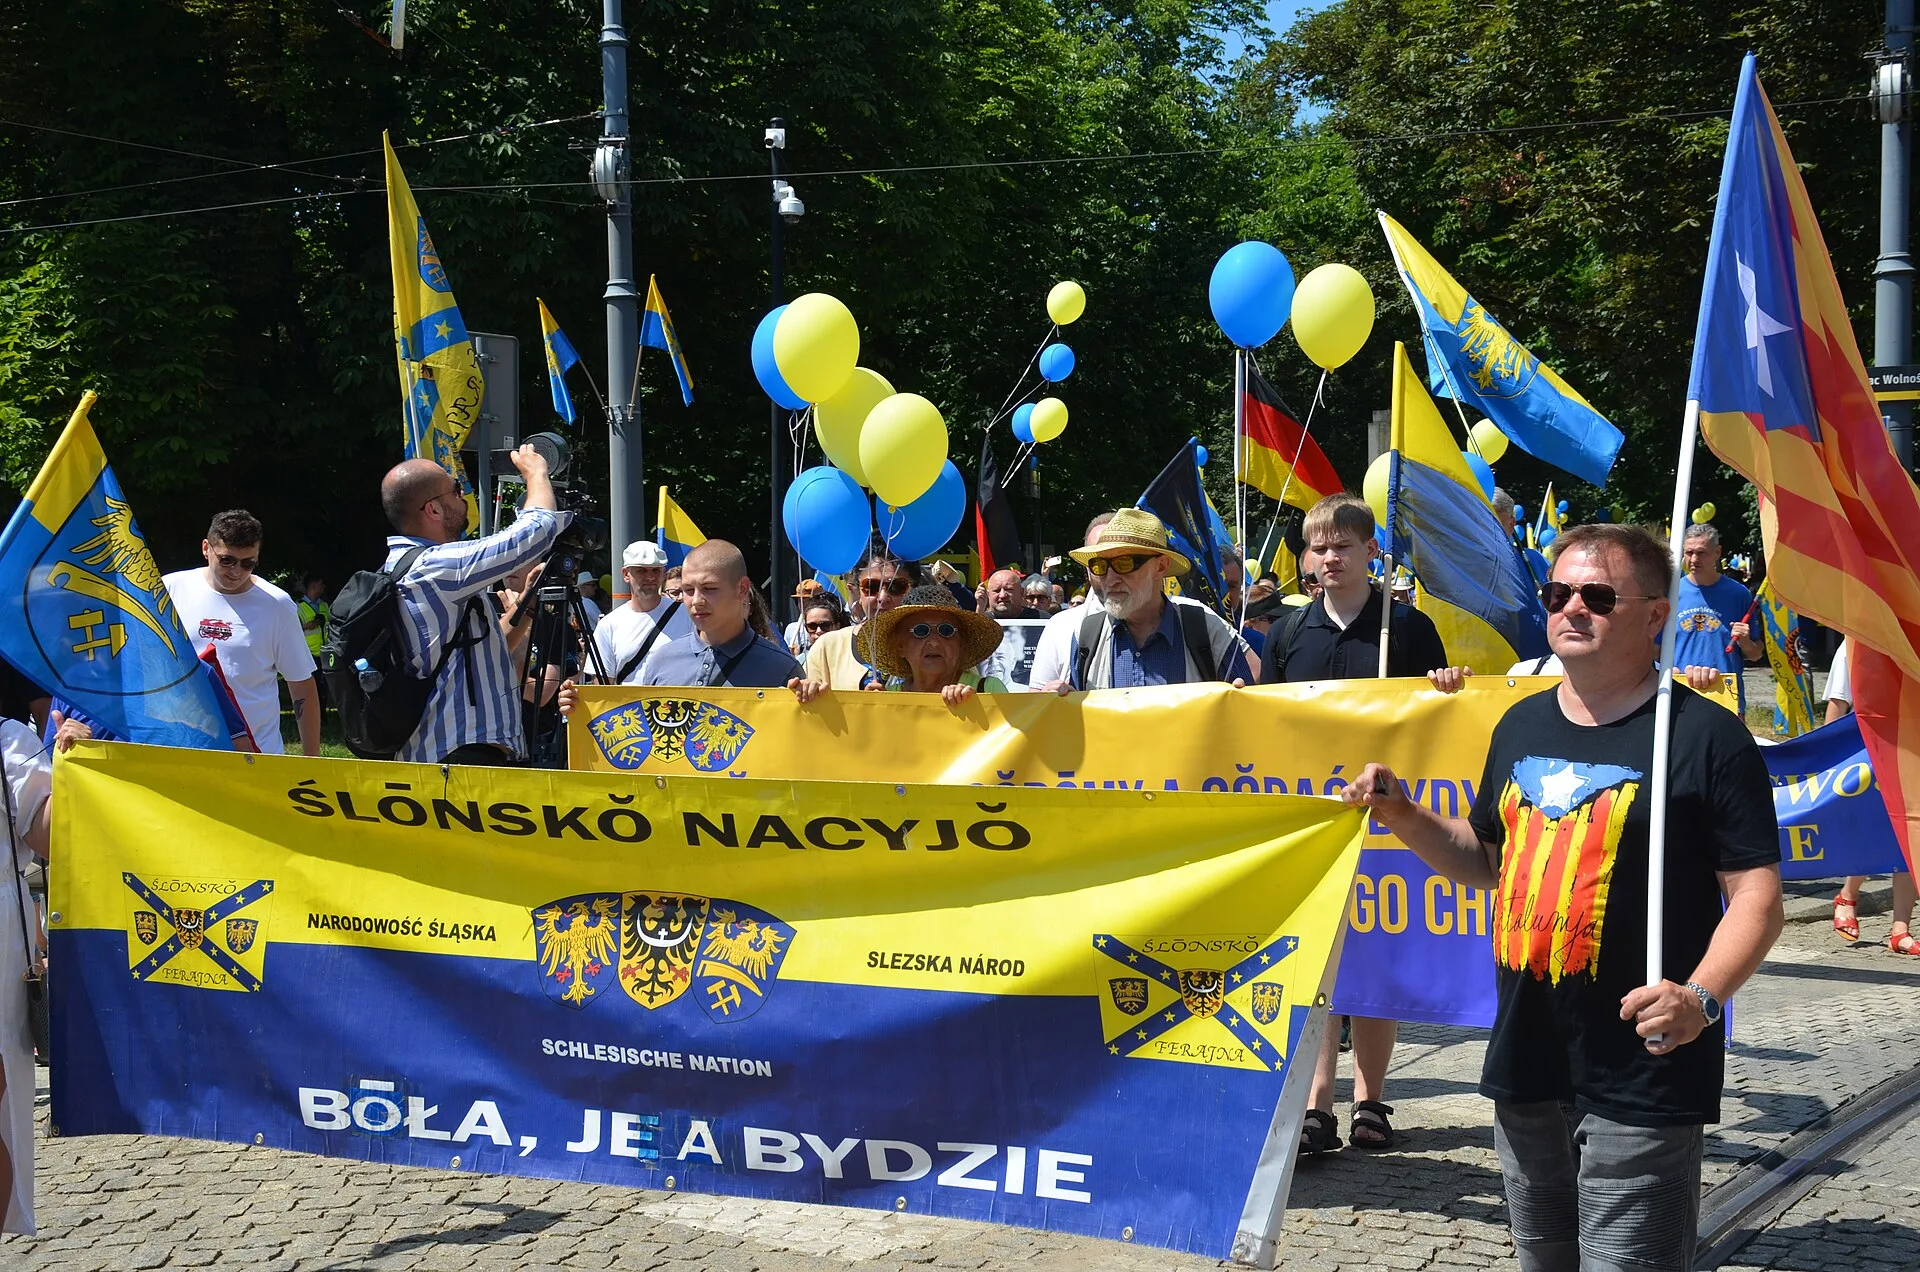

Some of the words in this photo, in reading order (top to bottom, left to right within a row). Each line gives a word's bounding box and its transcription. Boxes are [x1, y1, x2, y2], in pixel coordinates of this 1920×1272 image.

[287, 779, 653, 843] ŚLŌNSKŎ
[683, 802, 1032, 852] NACYJŎ
[1424, 874, 1497, 936] CH
[307, 913, 423, 938] NARODOWOŚĆ
[428, 916, 497, 943] ŚLĄSKA
[162, 967, 229, 987] FERAJNA
[867, 951, 952, 974] SLEZSKA
[959, 953, 1025, 977] NÁROD
[541, 1038, 684, 1069] SCHLESISCHE
[688, 1054, 773, 1077] NATION
[1154, 1040, 1246, 1064] FERAJNA
[566, 1108, 661, 1159] JE
[677, 1120, 723, 1165] A
[742, 1126, 1094, 1205] BYDZIE
